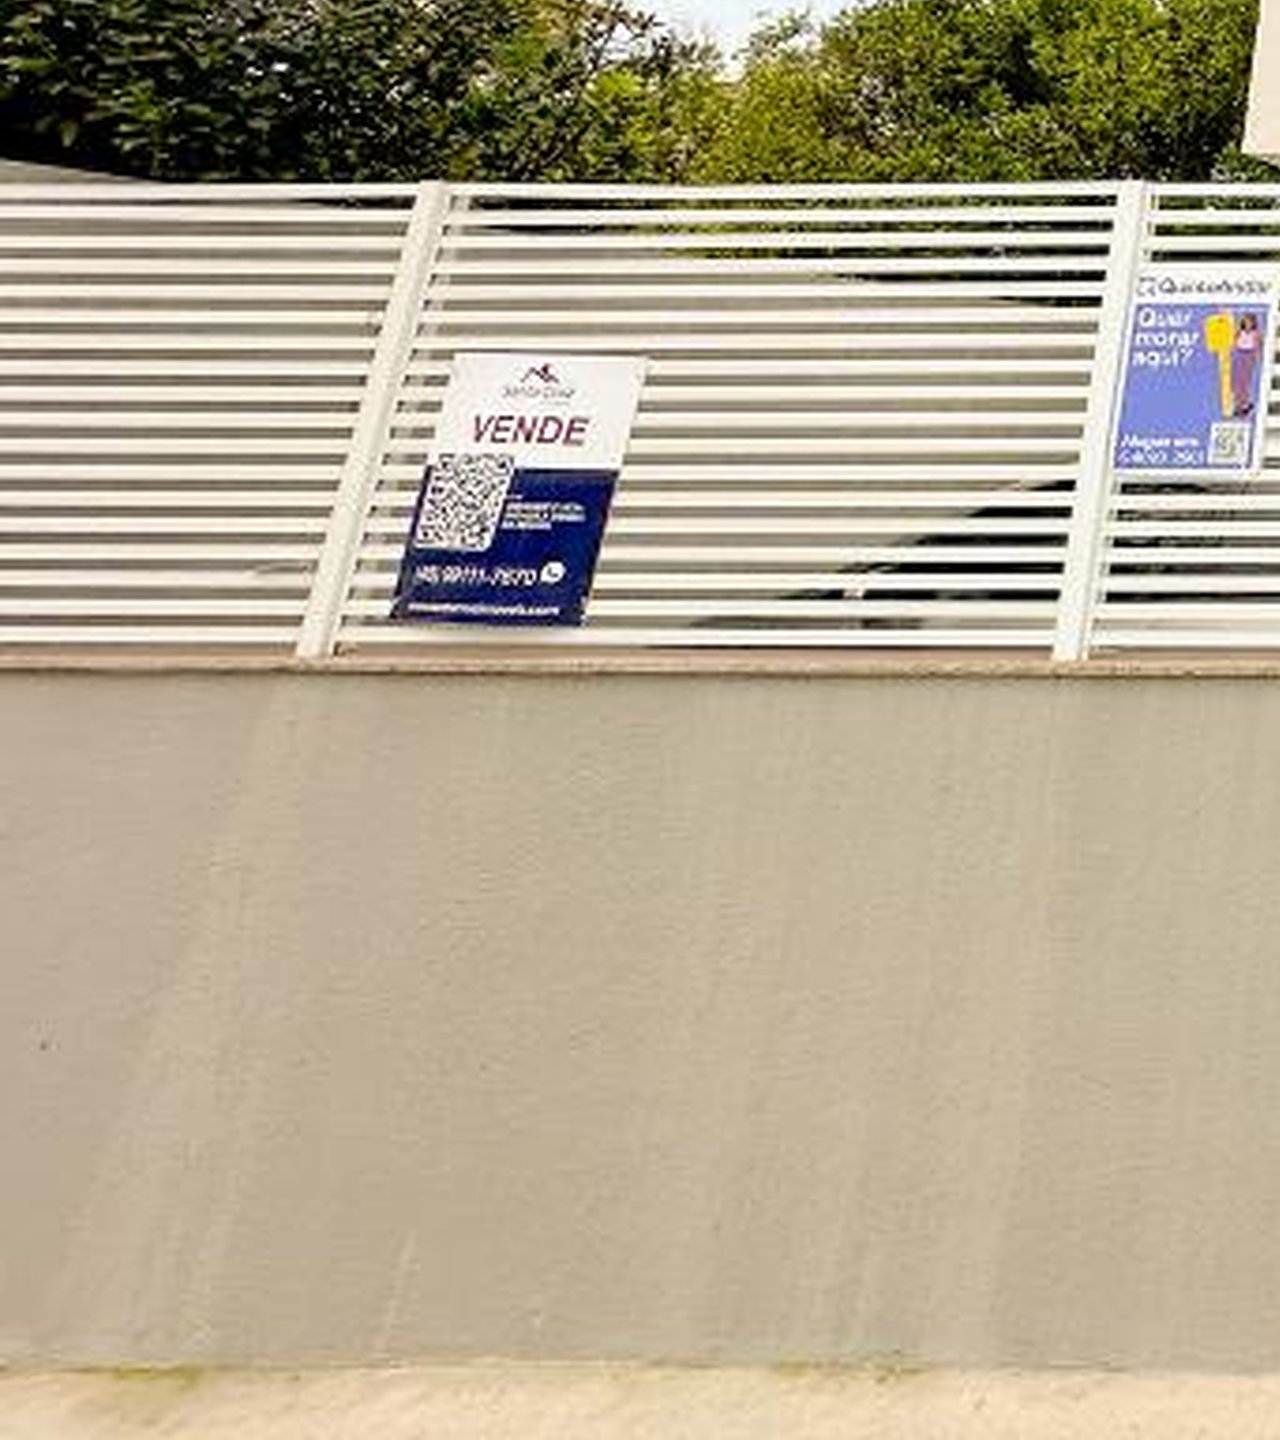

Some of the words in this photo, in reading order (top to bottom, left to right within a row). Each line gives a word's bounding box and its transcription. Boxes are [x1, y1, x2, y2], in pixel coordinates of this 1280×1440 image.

[1138, 309, 1193, 328] Quer
[1135, 331, 1200, 346] morar
[472, 414, 590, 446] VENDE
